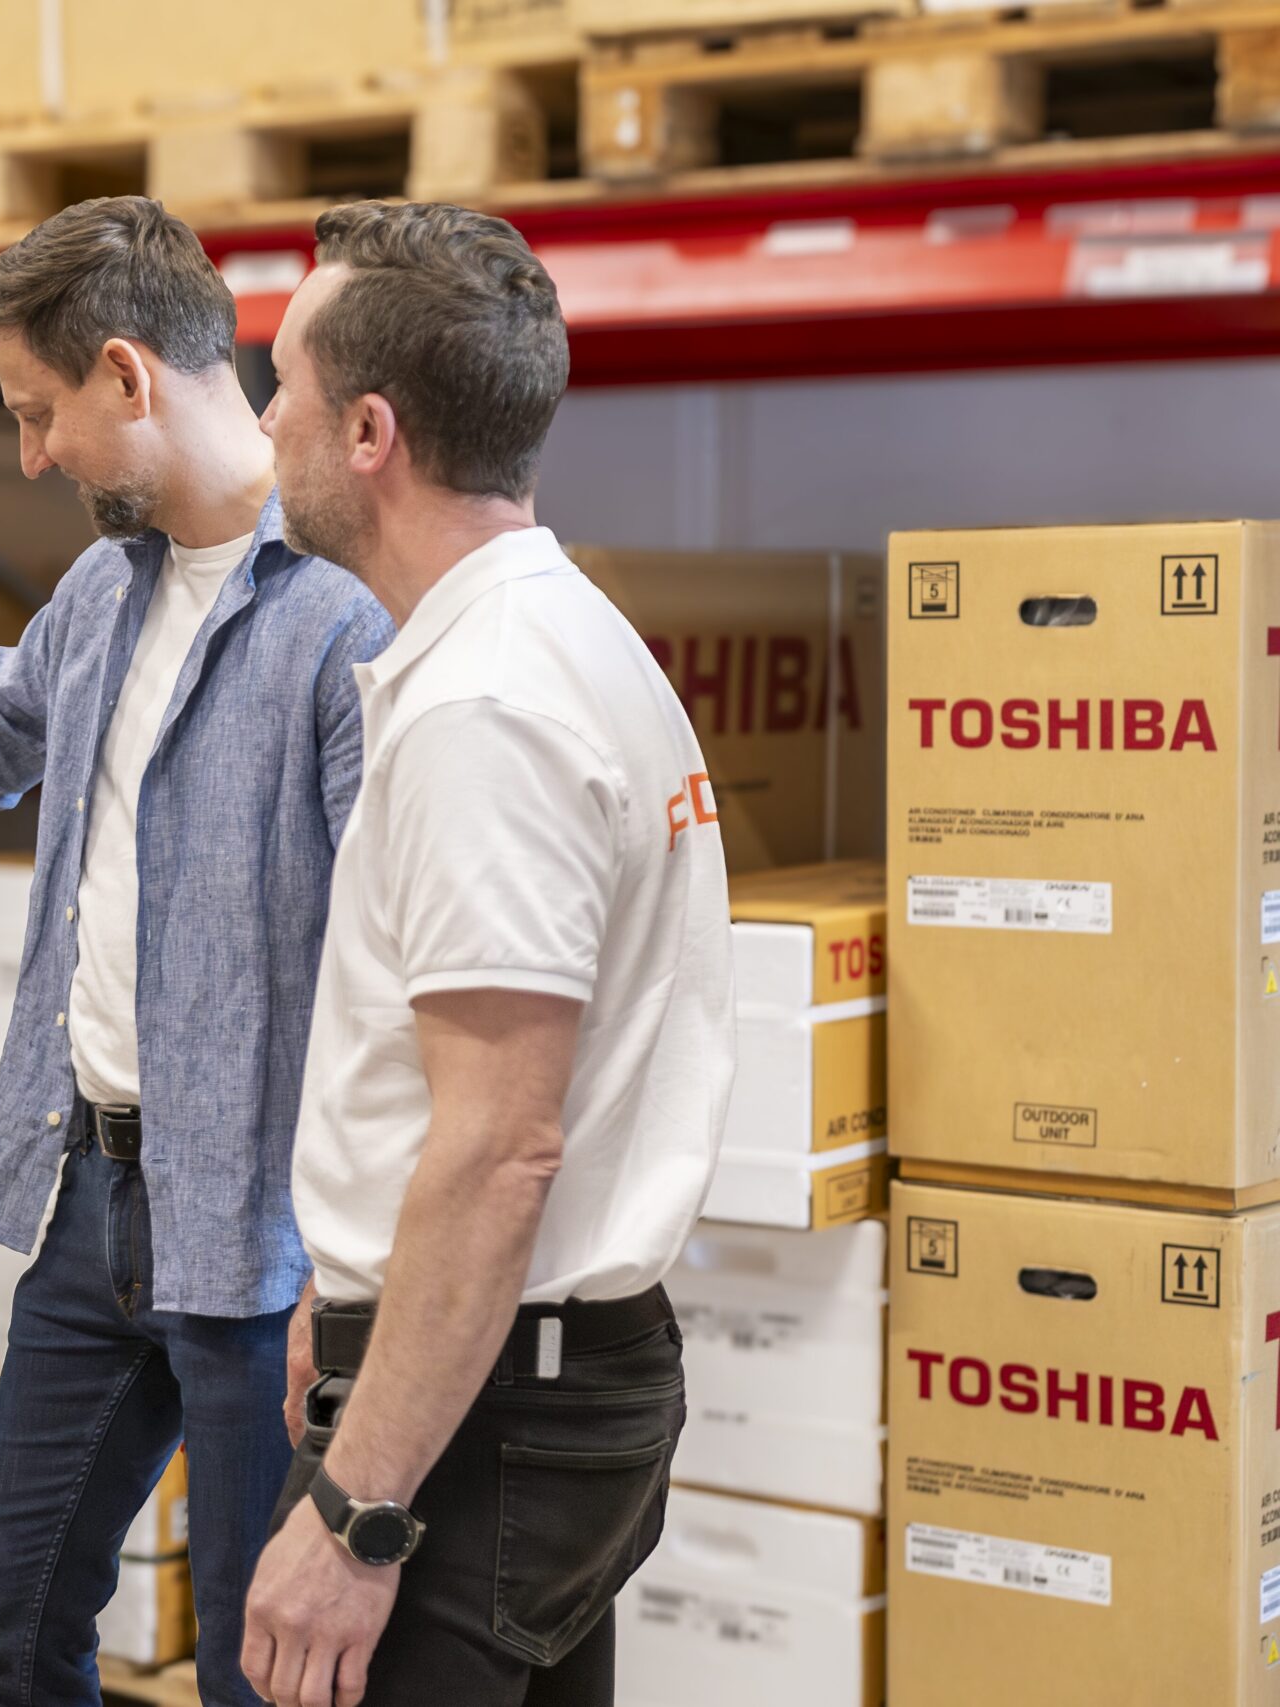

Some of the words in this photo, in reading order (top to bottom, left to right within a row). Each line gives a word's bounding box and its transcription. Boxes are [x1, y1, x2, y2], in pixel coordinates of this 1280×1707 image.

[908, 699, 1218, 752] TOSHIBA
[826, 1115, 848, 1138] AIR
[1022, 1107, 1089, 1126] OUTDOOR
[1039, 1126, 1070, 1141] UNIT
[907, 1348, 1220, 1441] TOSHIBA
